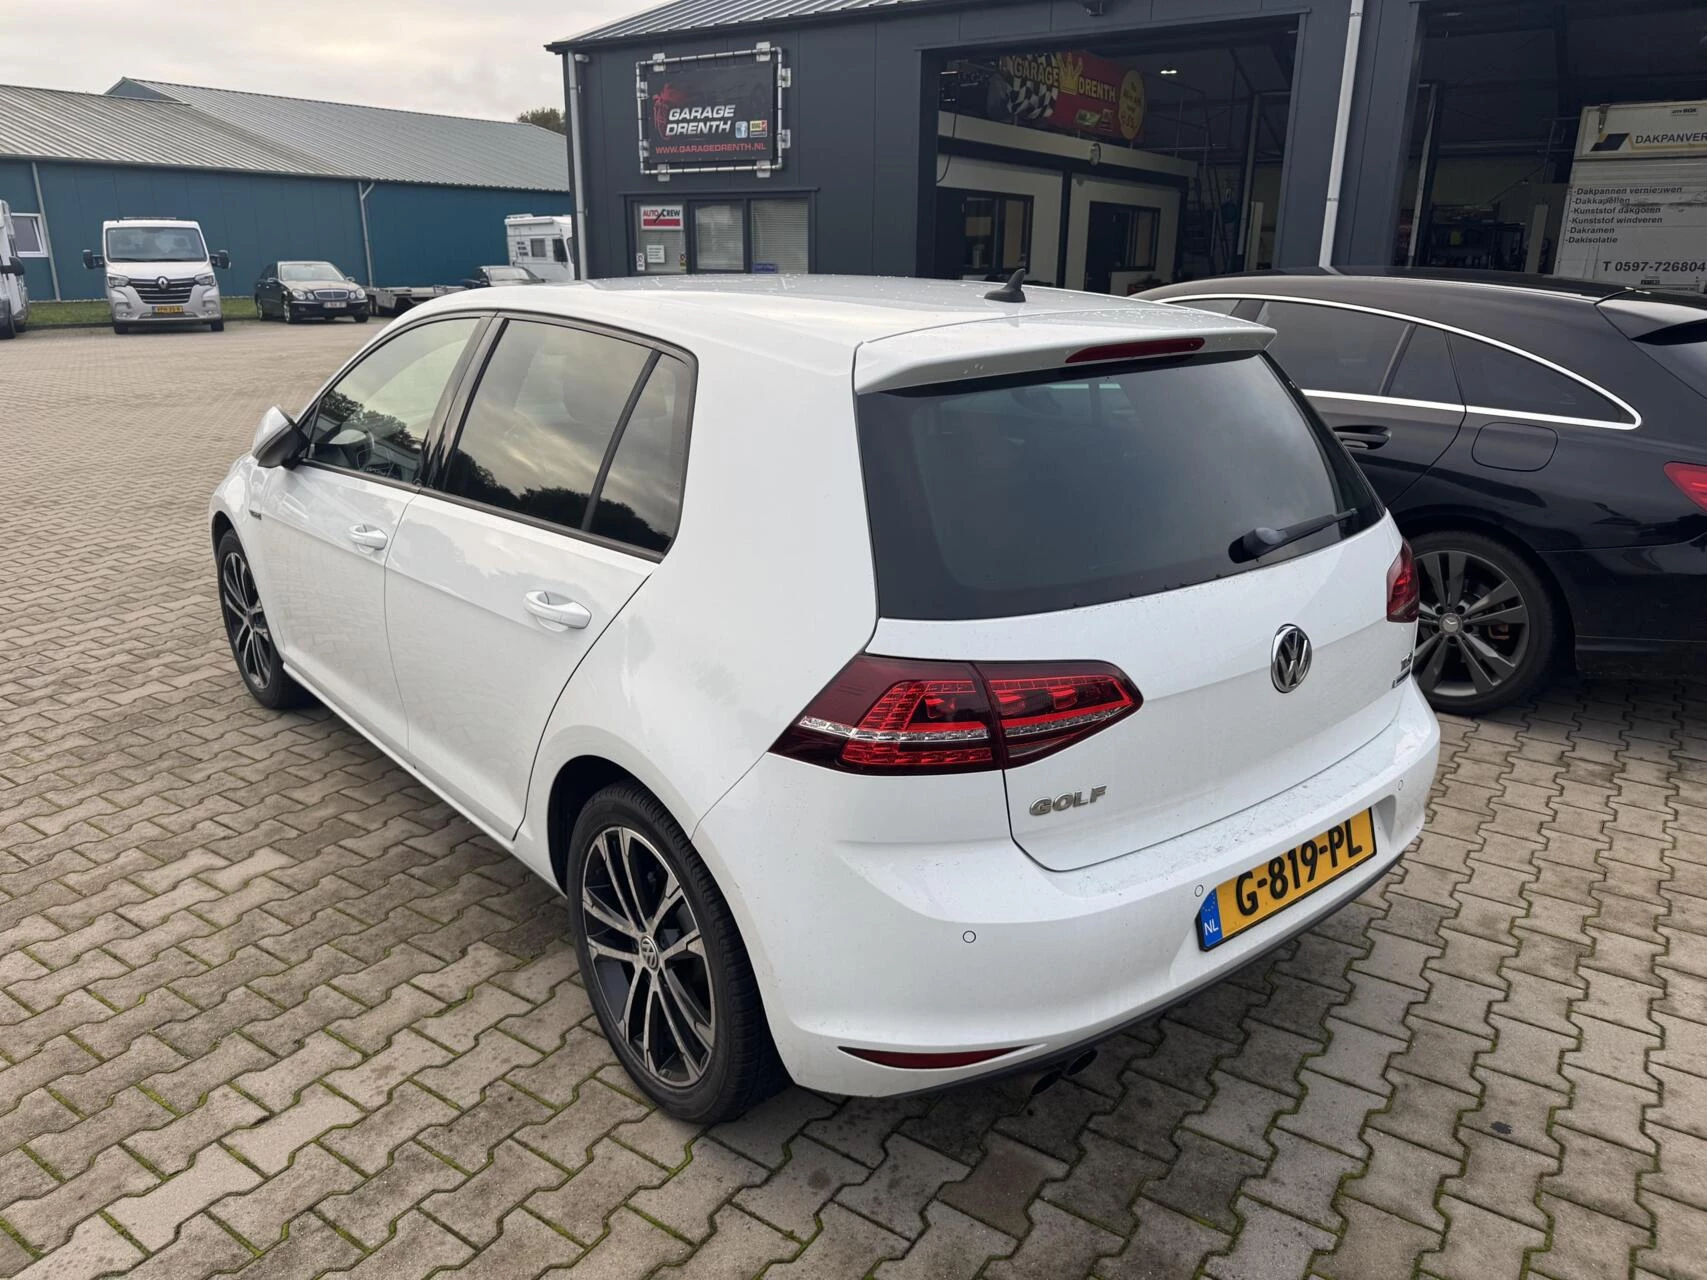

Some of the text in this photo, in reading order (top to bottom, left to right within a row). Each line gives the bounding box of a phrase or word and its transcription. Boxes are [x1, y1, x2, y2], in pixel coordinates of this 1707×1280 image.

[1013, 58, 1116, 102] GARAGE DRENTH
[668, 105, 736, 120] GARAGE
[665, 120, 732, 136] DRENTH
[655, 143, 767, 154] WWW.GARAGEDRENTH.NL
[1616, 216, 1663, 225] windveren
[1603, 261, 1706, 273] T 0597-726804
[1029, 784, 1107, 816] GOLF
[1235, 818, 1363, 917] G-819-PL
[1204, 918, 1220, 935] NL
